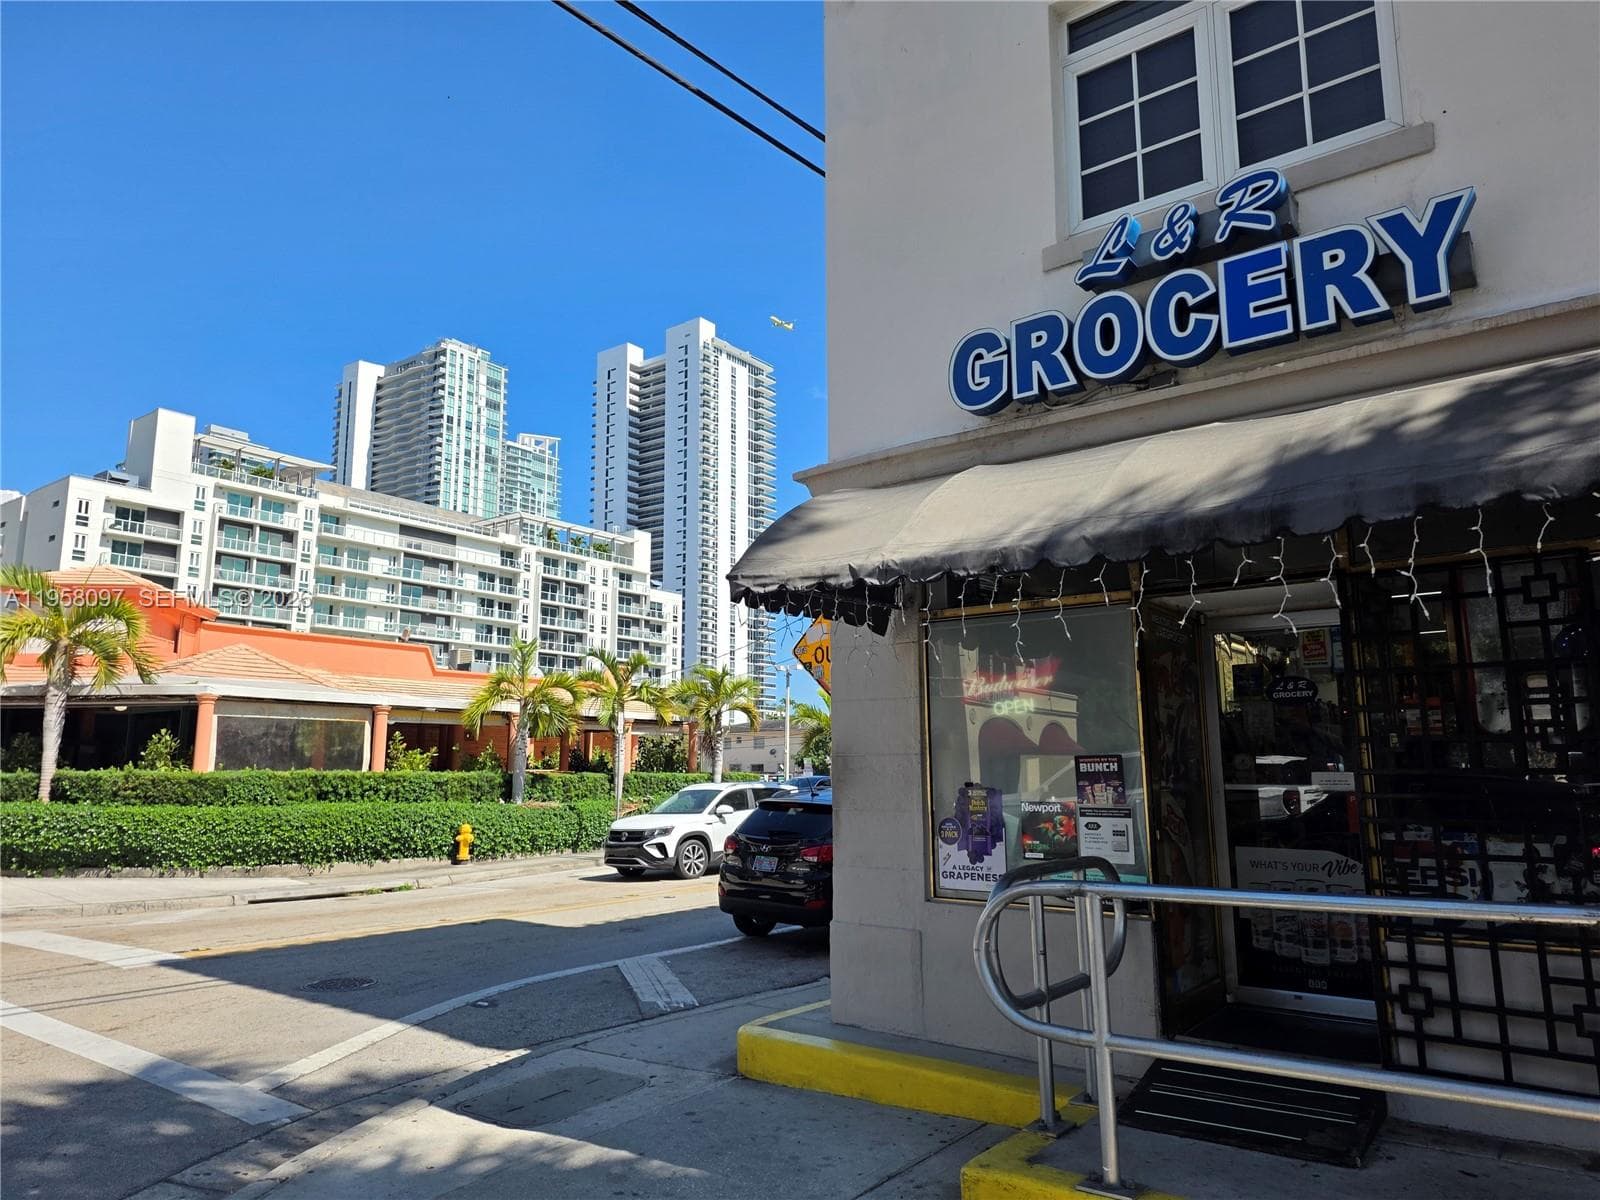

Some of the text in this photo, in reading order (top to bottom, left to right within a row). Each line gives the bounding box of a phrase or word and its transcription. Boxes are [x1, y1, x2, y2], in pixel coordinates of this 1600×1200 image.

[1074, 167, 1288, 290] L & R
[948, 186, 1477, 416] GROCERY
[1272, 689, 1314, 699] GROCERY
[993, 697, 1035, 715] OPEN
[1079, 762, 1118, 773] BUNCH
[1021, 802, 1062, 813] Newport
[945, 831, 959, 839] PACK
[1250, 860, 1289, 871] WHAT'S
[1291, 861, 1320, 873] YOUR
